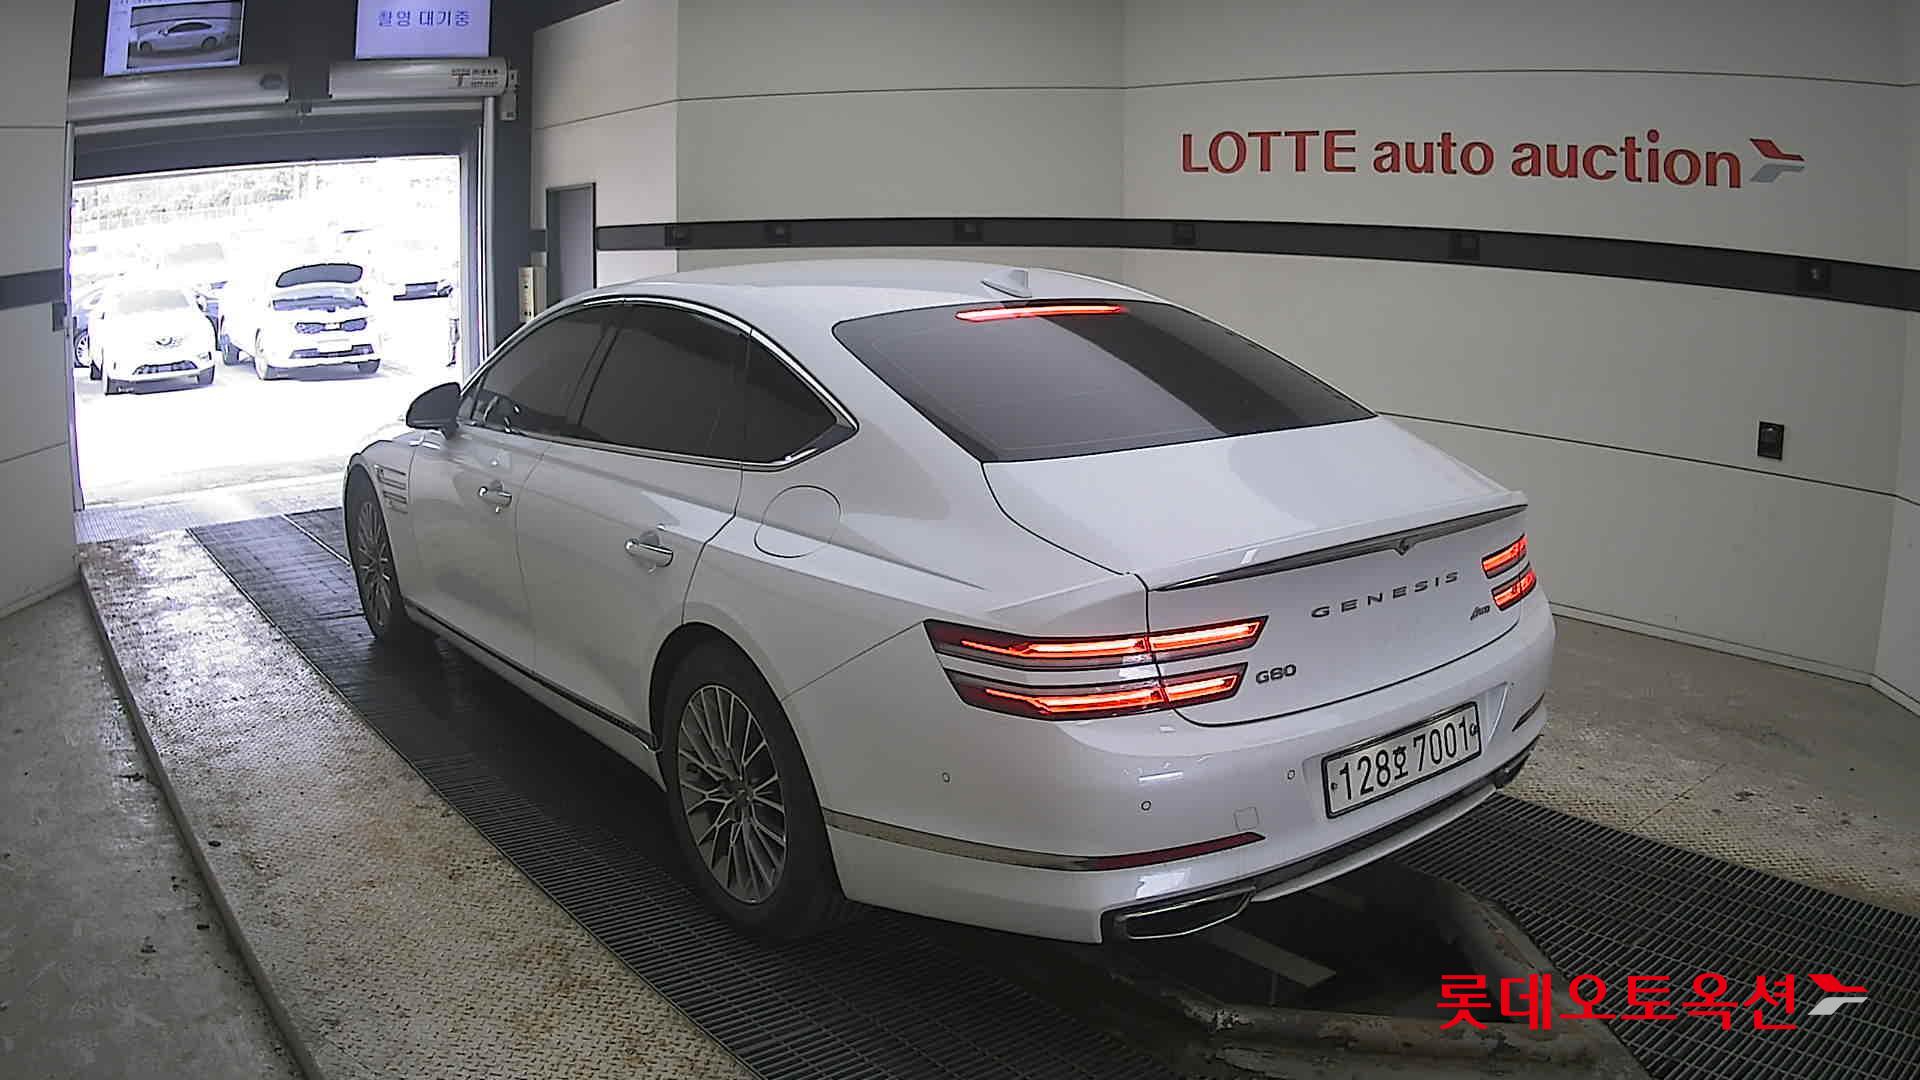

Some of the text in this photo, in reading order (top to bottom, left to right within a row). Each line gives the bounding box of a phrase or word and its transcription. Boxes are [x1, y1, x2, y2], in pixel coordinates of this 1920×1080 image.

[419, 10, 470, 27] 대기중
[1182, 129, 1742, 189] LOTTE auto auction
[1311, 571, 1458, 618] GENESIS
[1339, 716, 1469, 800] 128호 7001
